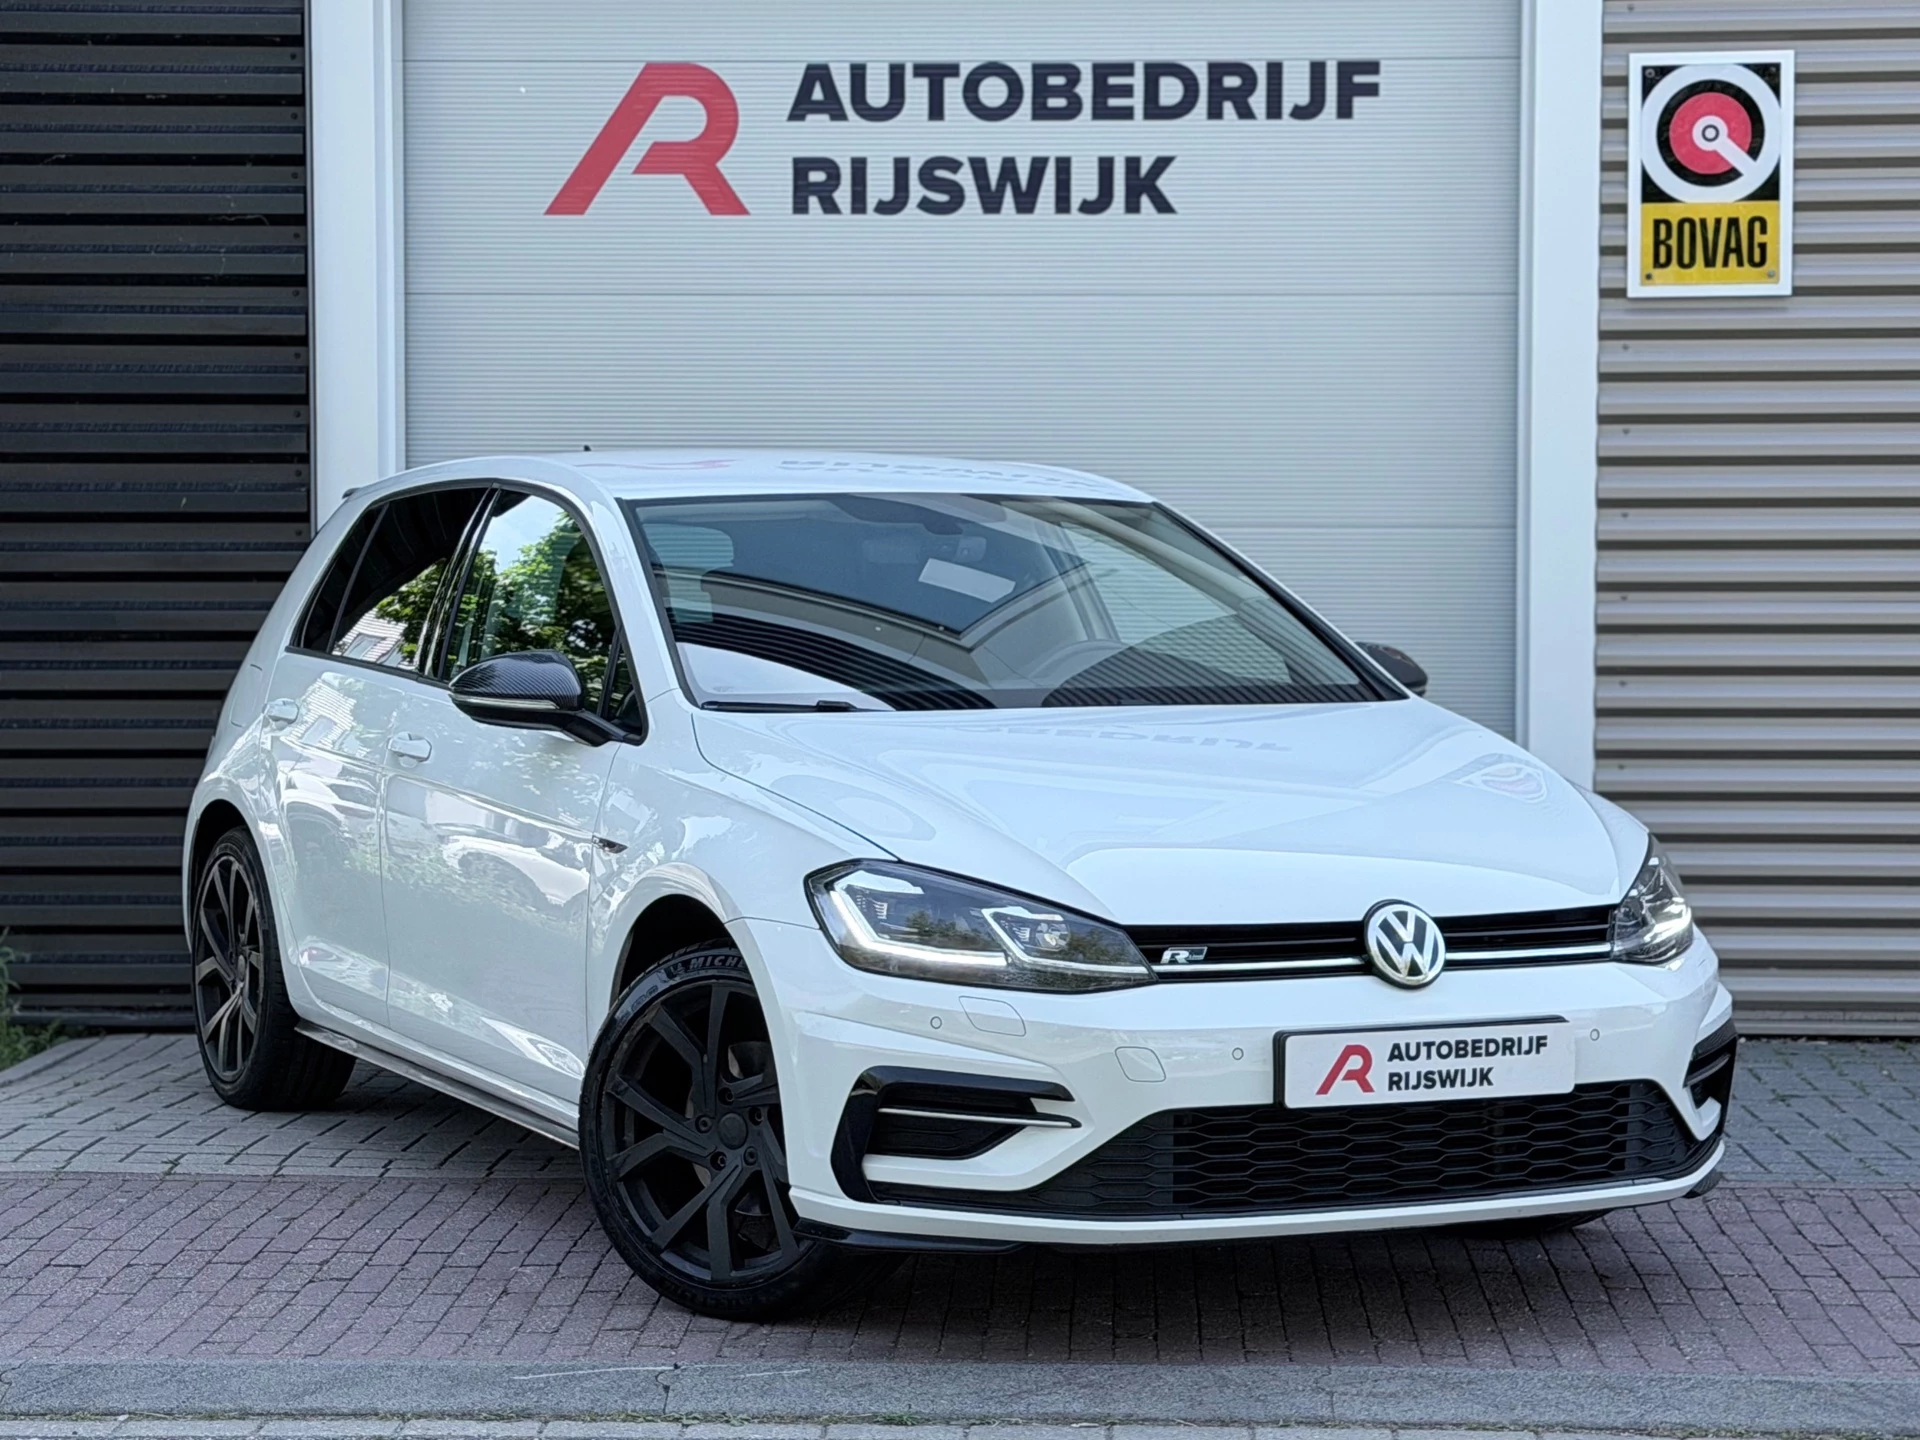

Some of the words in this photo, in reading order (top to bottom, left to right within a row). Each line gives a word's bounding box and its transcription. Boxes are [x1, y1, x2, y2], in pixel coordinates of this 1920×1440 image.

[788, 61, 1380, 122] AUTOBEDRIJF
[793, 156, 1176, 215] RIJSWIJK
[1653, 215, 1768, 270] BOVAG
[1387, 1035, 1548, 1062] AUTOBEDRIJF
[1388, 1067, 1494, 1091] RIJSWIJK
